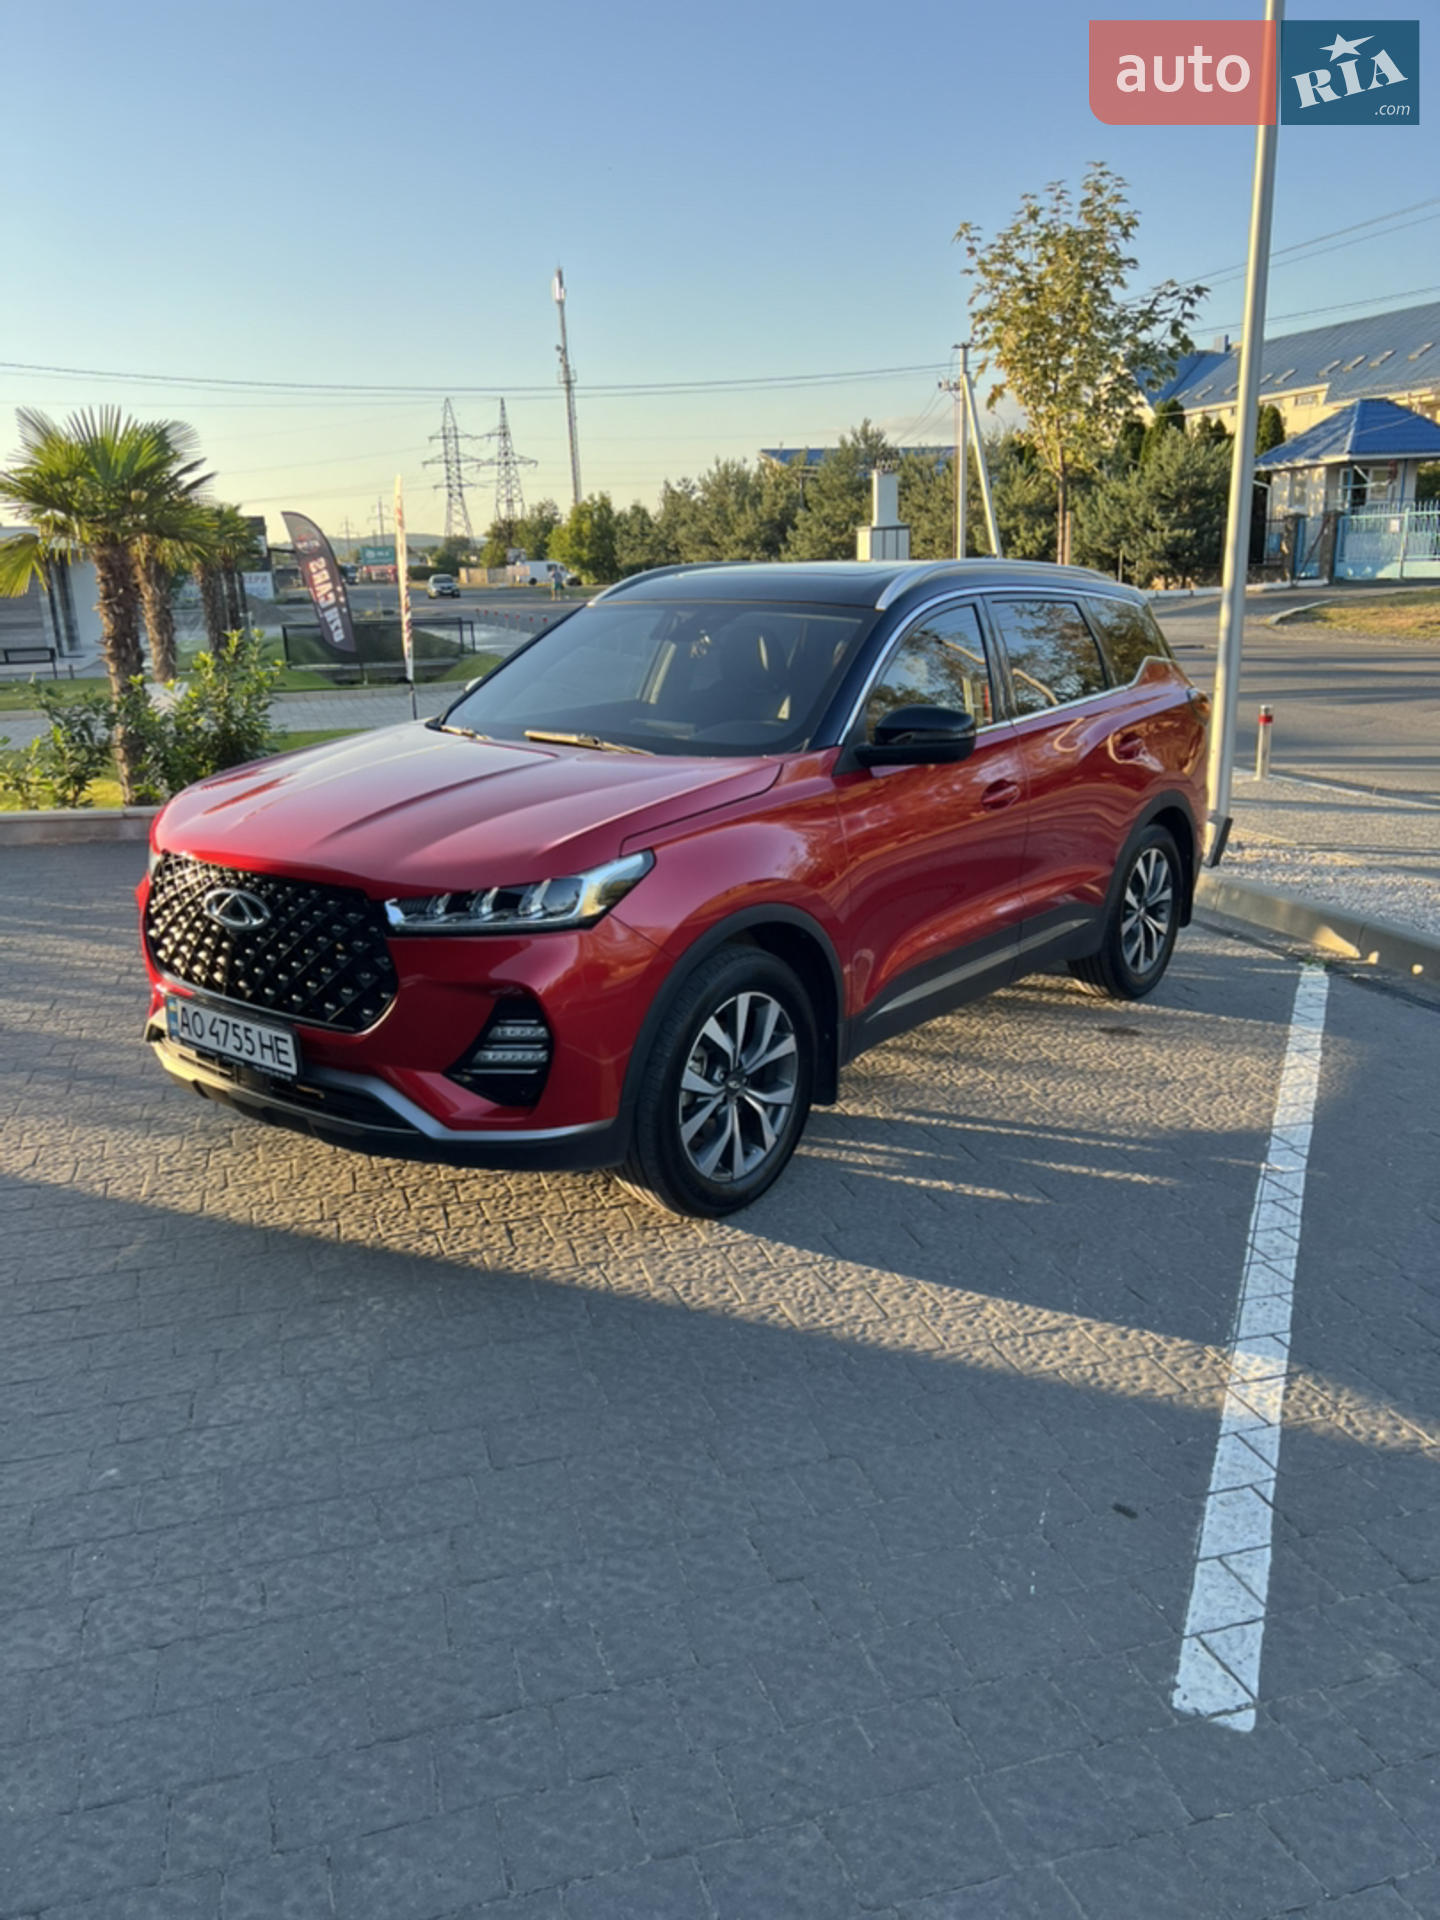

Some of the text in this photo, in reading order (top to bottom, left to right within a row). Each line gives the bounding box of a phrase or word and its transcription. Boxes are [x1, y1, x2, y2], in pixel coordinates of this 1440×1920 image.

[180, 1006, 292, 1069] AO 4755 HE
